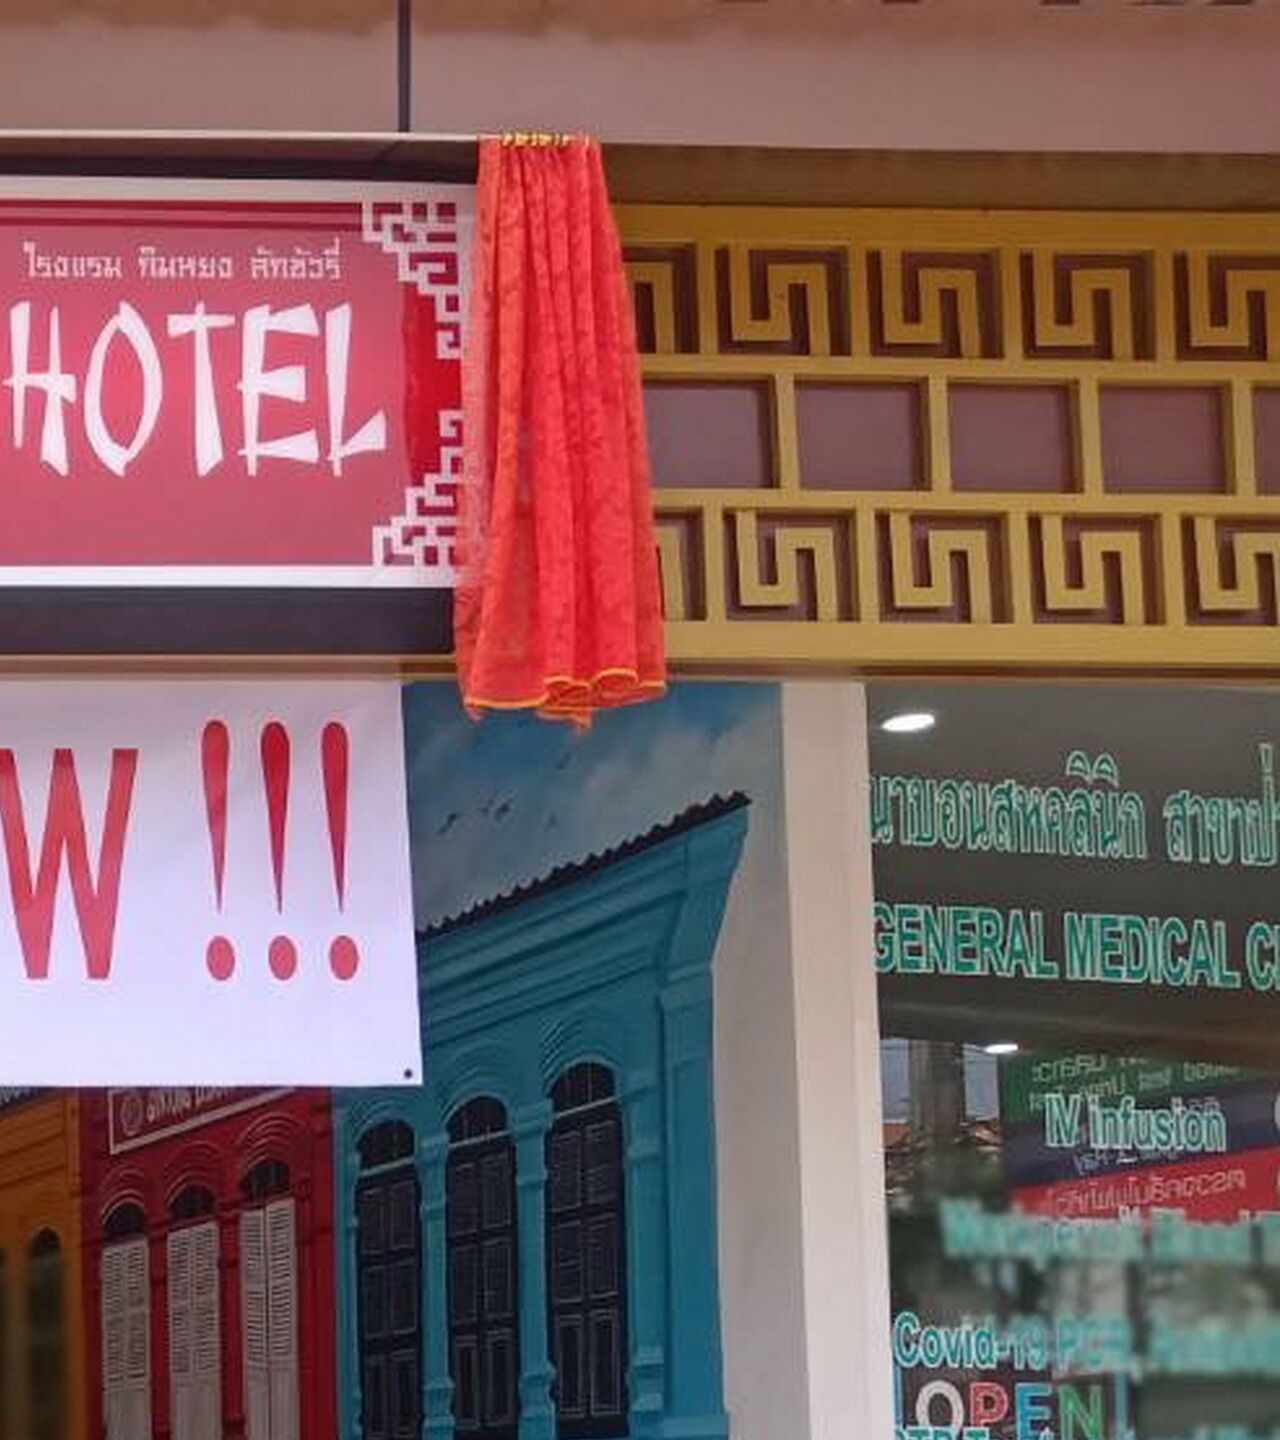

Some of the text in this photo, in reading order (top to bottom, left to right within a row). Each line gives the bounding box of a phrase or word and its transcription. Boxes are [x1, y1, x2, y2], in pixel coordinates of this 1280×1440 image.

[2, 300, 388, 478] HOTEL
[200, 719, 360, 982] !!!
[874, 902, 1280, 991] GENERAL MEDICAL C
